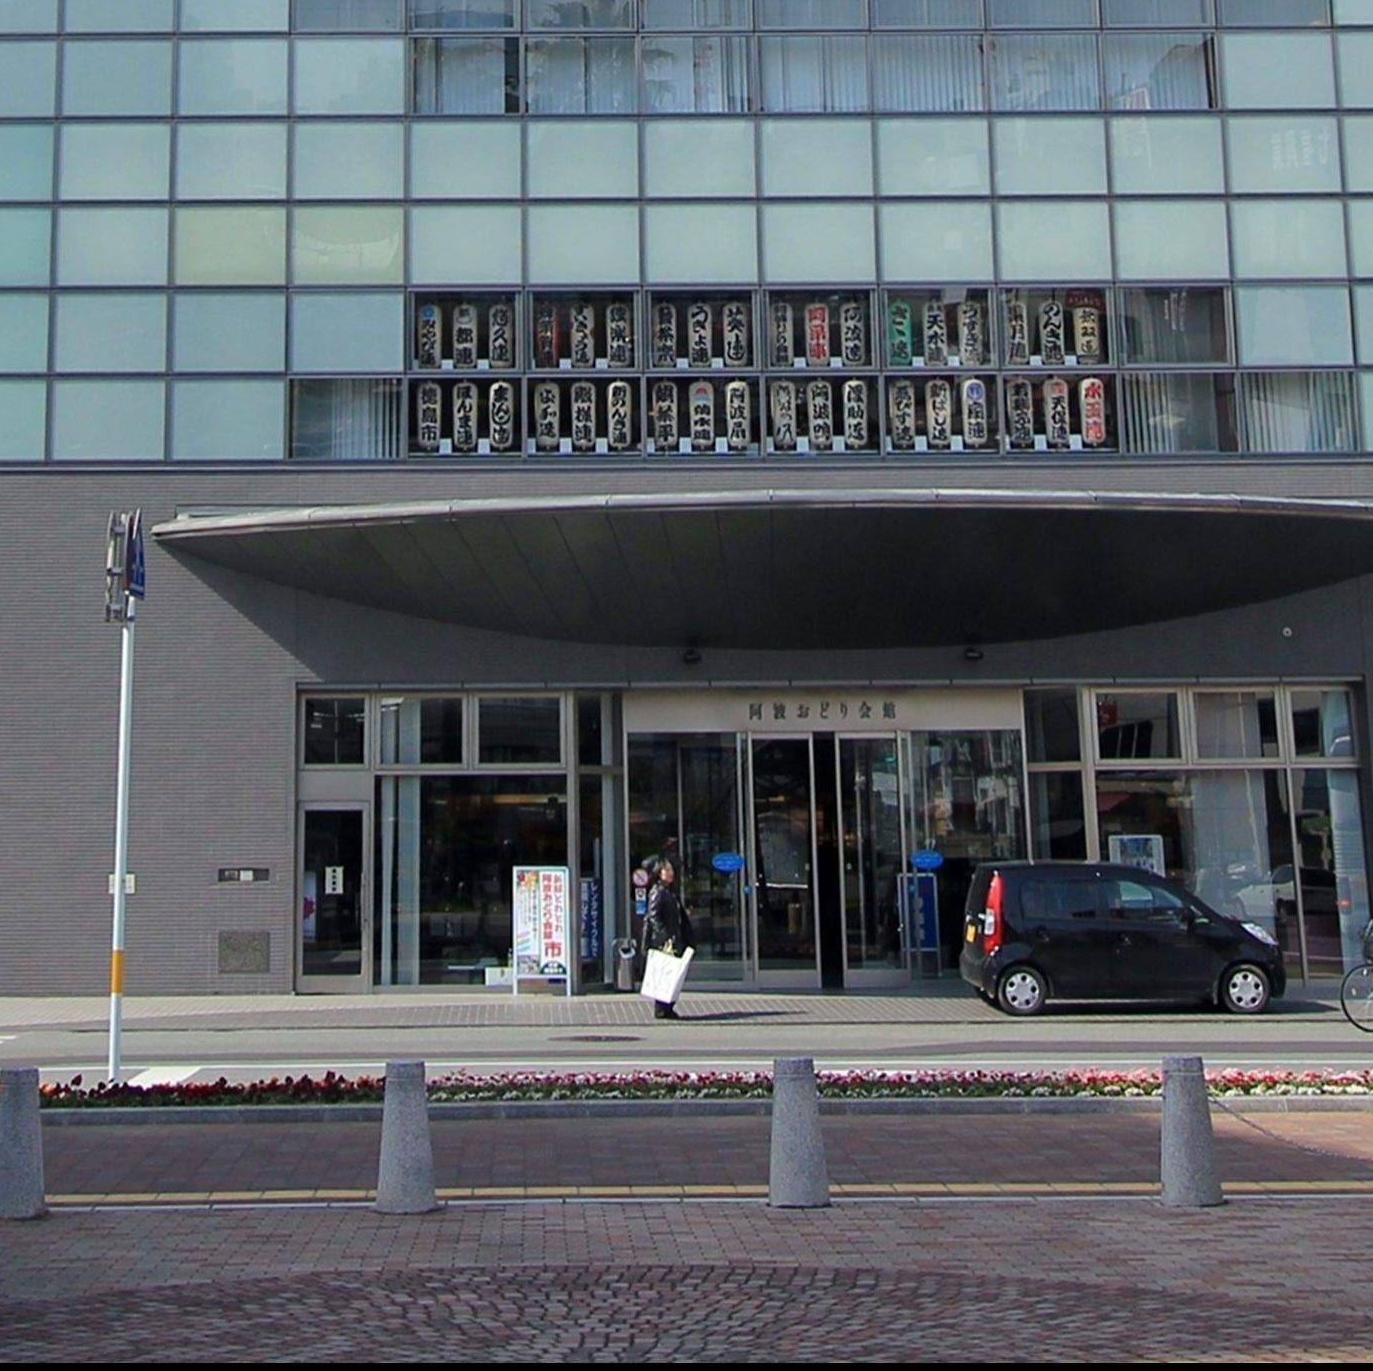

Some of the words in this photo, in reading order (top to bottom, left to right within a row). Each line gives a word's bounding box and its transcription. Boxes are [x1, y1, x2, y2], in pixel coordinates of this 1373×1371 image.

[748, 699, 897, 721] 阿波おどり会館
